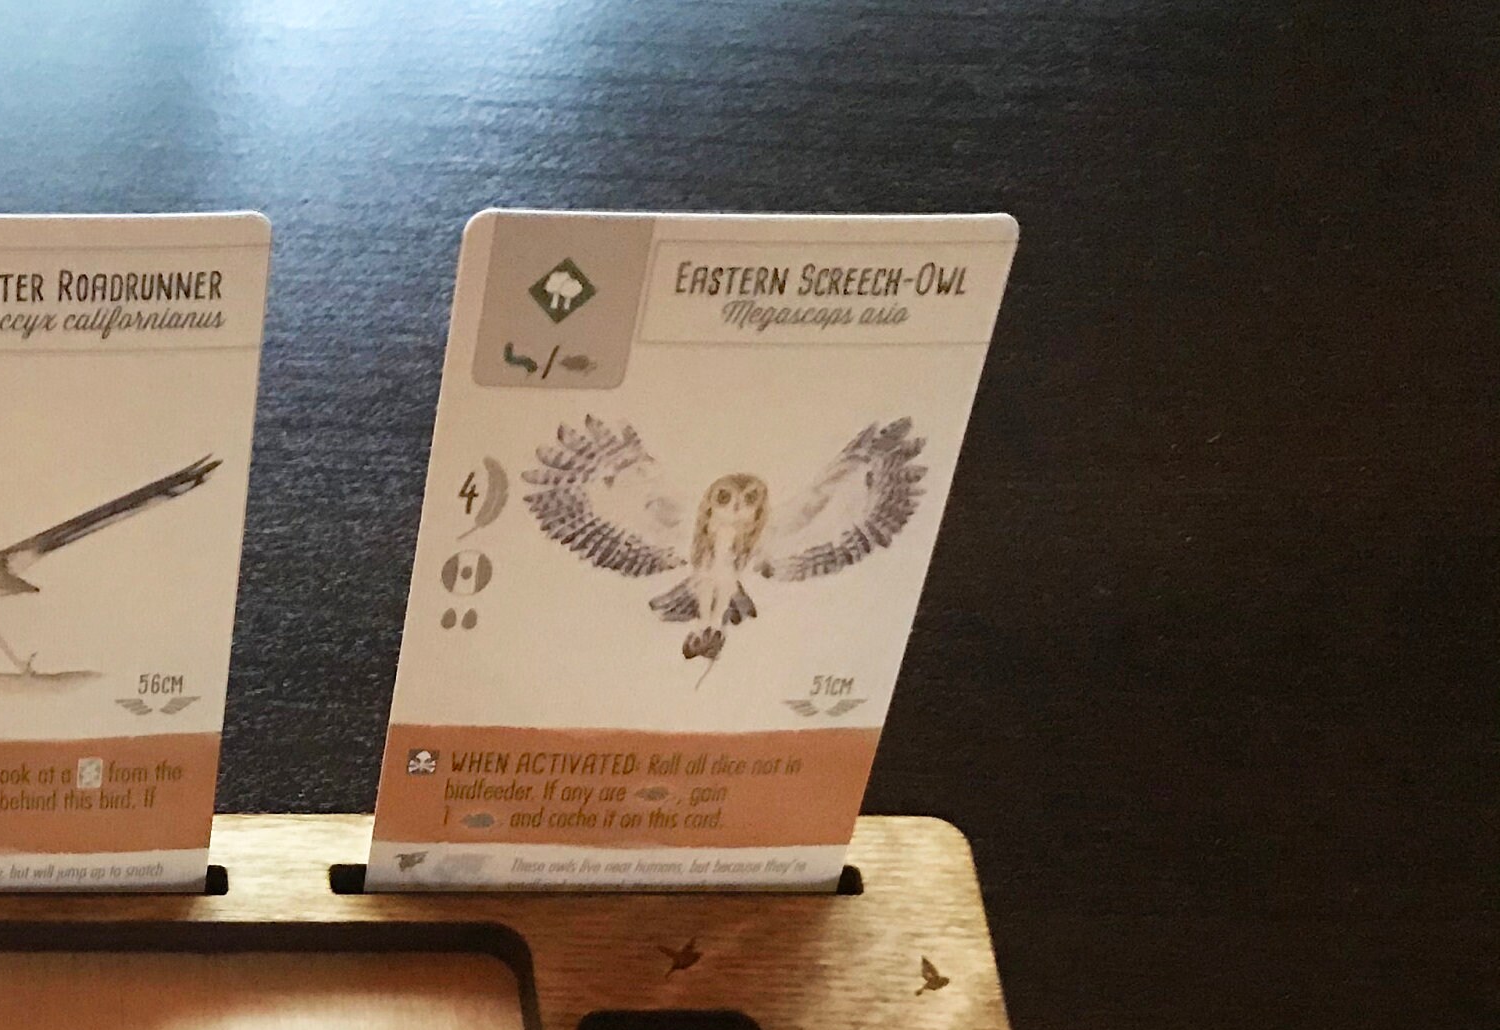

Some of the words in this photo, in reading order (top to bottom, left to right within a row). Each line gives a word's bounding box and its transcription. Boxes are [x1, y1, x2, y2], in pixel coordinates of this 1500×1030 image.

[63, 305, 227, 339] californianus
[722, 300, 853, 331] Megascops
[458, 471, 479, 515] 4
[138, 674, 184, 695] 56CM
[809, 675, 855, 696] 51CM
[38, 764, 55, 784] at
[61, 768, 71, 784] a
[108, 760, 148, 783] from
[155, 759, 183, 782] the
[452, 751, 510, 774] WHEN
[647, 753, 680, 776] Roll
[685, 753, 707, 775] all
[711, 755, 747, 775] dice
[751, 757, 780, 775] not
[785, 756, 803, 775] in
[0, 789, 58, 812] behind
[64, 789, 94, 811] this
[100, 788, 137, 810] bird.
[143, 786, 157, 809] If
[543, 779, 558, 801] If
[561, 784, 594, 805] any
[599, 786, 627, 801] are
[690, 783, 728, 806] gain
[509, 806, 547, 828] and
[549, 805, 598, 829] cache
[602, 807, 617, 828] it
[620, 811, 642, 829] on
[648, 808, 679, 829] this
